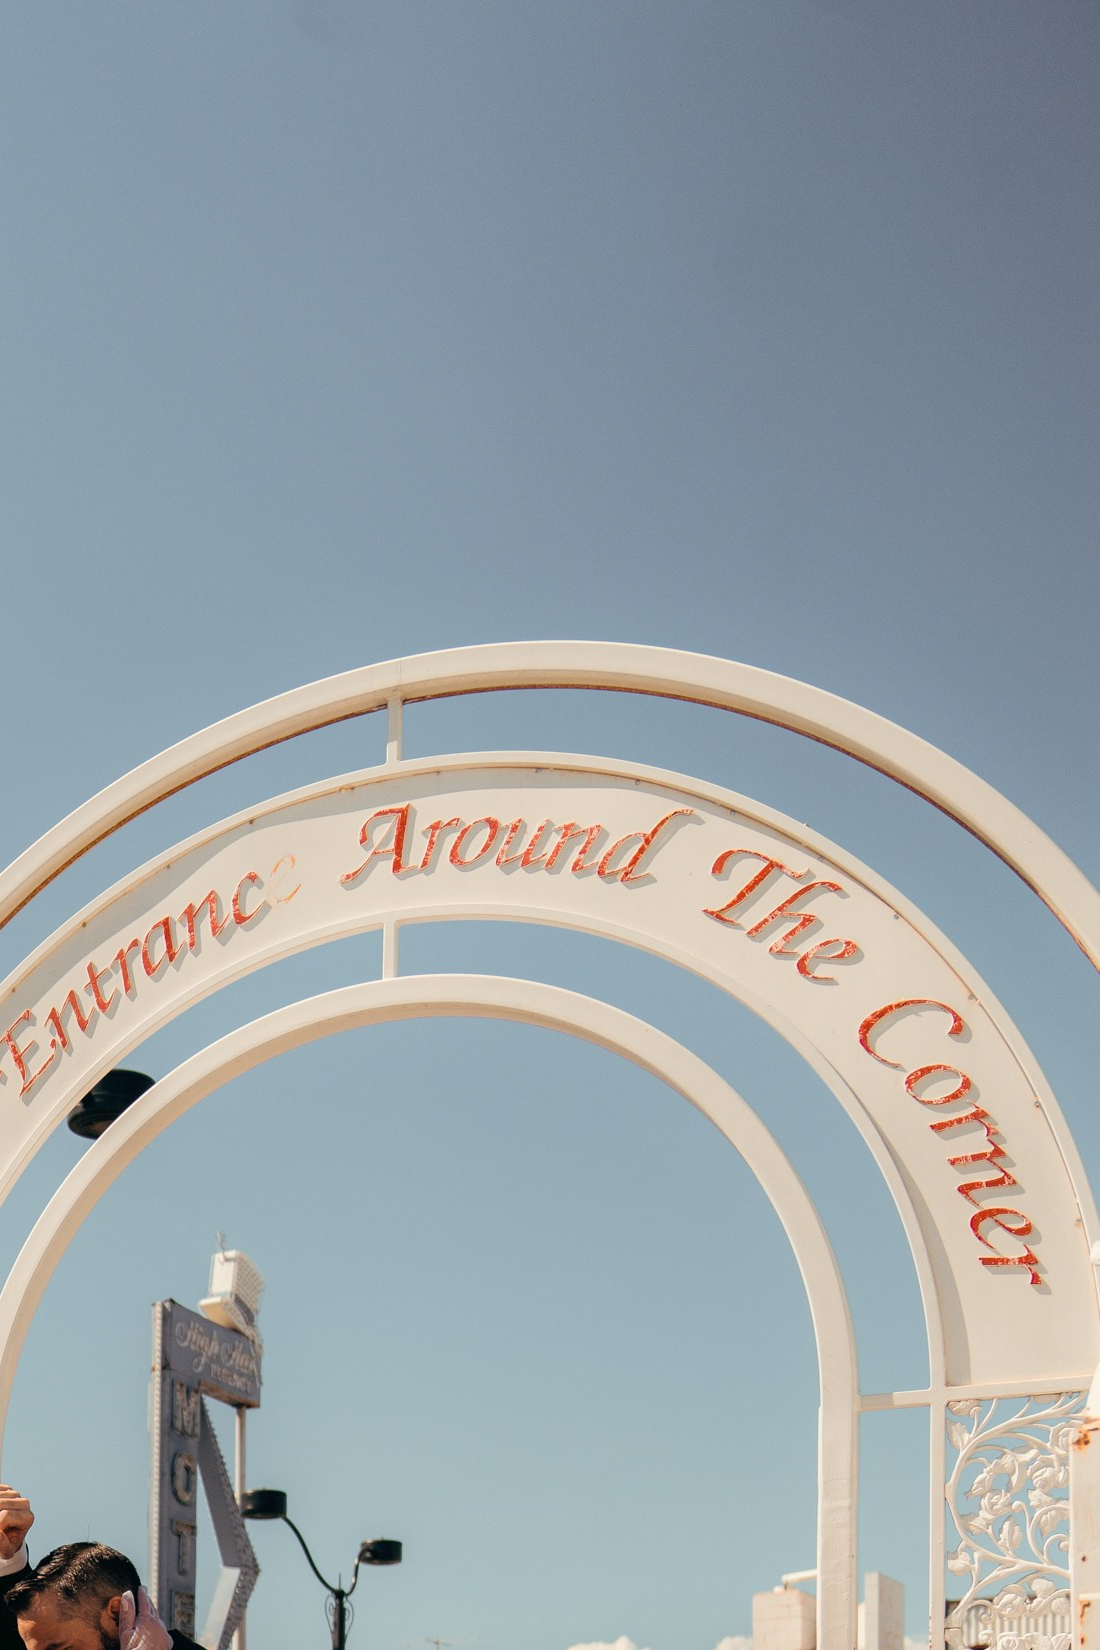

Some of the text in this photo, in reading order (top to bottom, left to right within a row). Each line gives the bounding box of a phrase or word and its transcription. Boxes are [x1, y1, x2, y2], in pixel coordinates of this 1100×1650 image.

[338, 802, 696, 884] Around
[702, 847, 859, 982] The
[857, 998, 1043, 1286] Corner
[172, 1379, 200, 1638] MOTE
